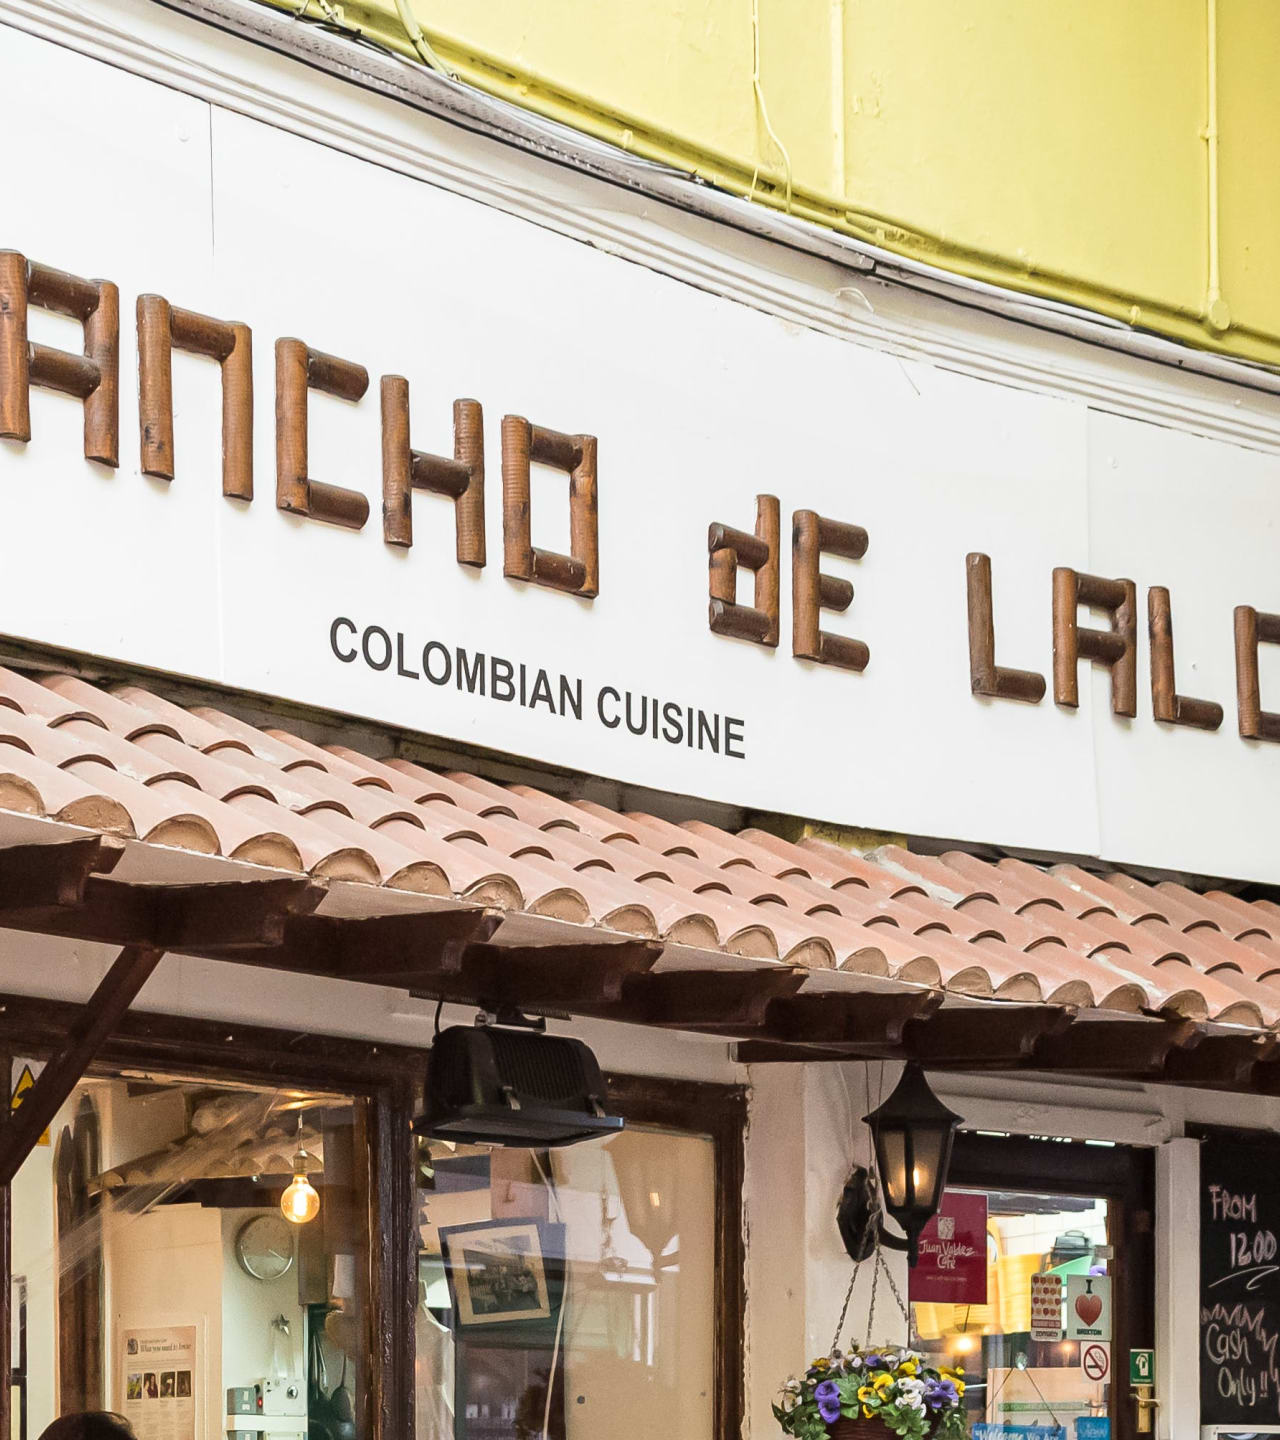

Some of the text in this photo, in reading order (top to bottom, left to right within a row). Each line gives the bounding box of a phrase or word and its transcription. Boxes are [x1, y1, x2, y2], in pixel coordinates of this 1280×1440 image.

[330, 616, 746, 760] COLOMBIAN CUISINE
[1208, 1184, 1258, 1223] FROM
[919, 1239, 976, 1257] Juan Valdez
[1205, 1324, 1252, 1365] Cash
